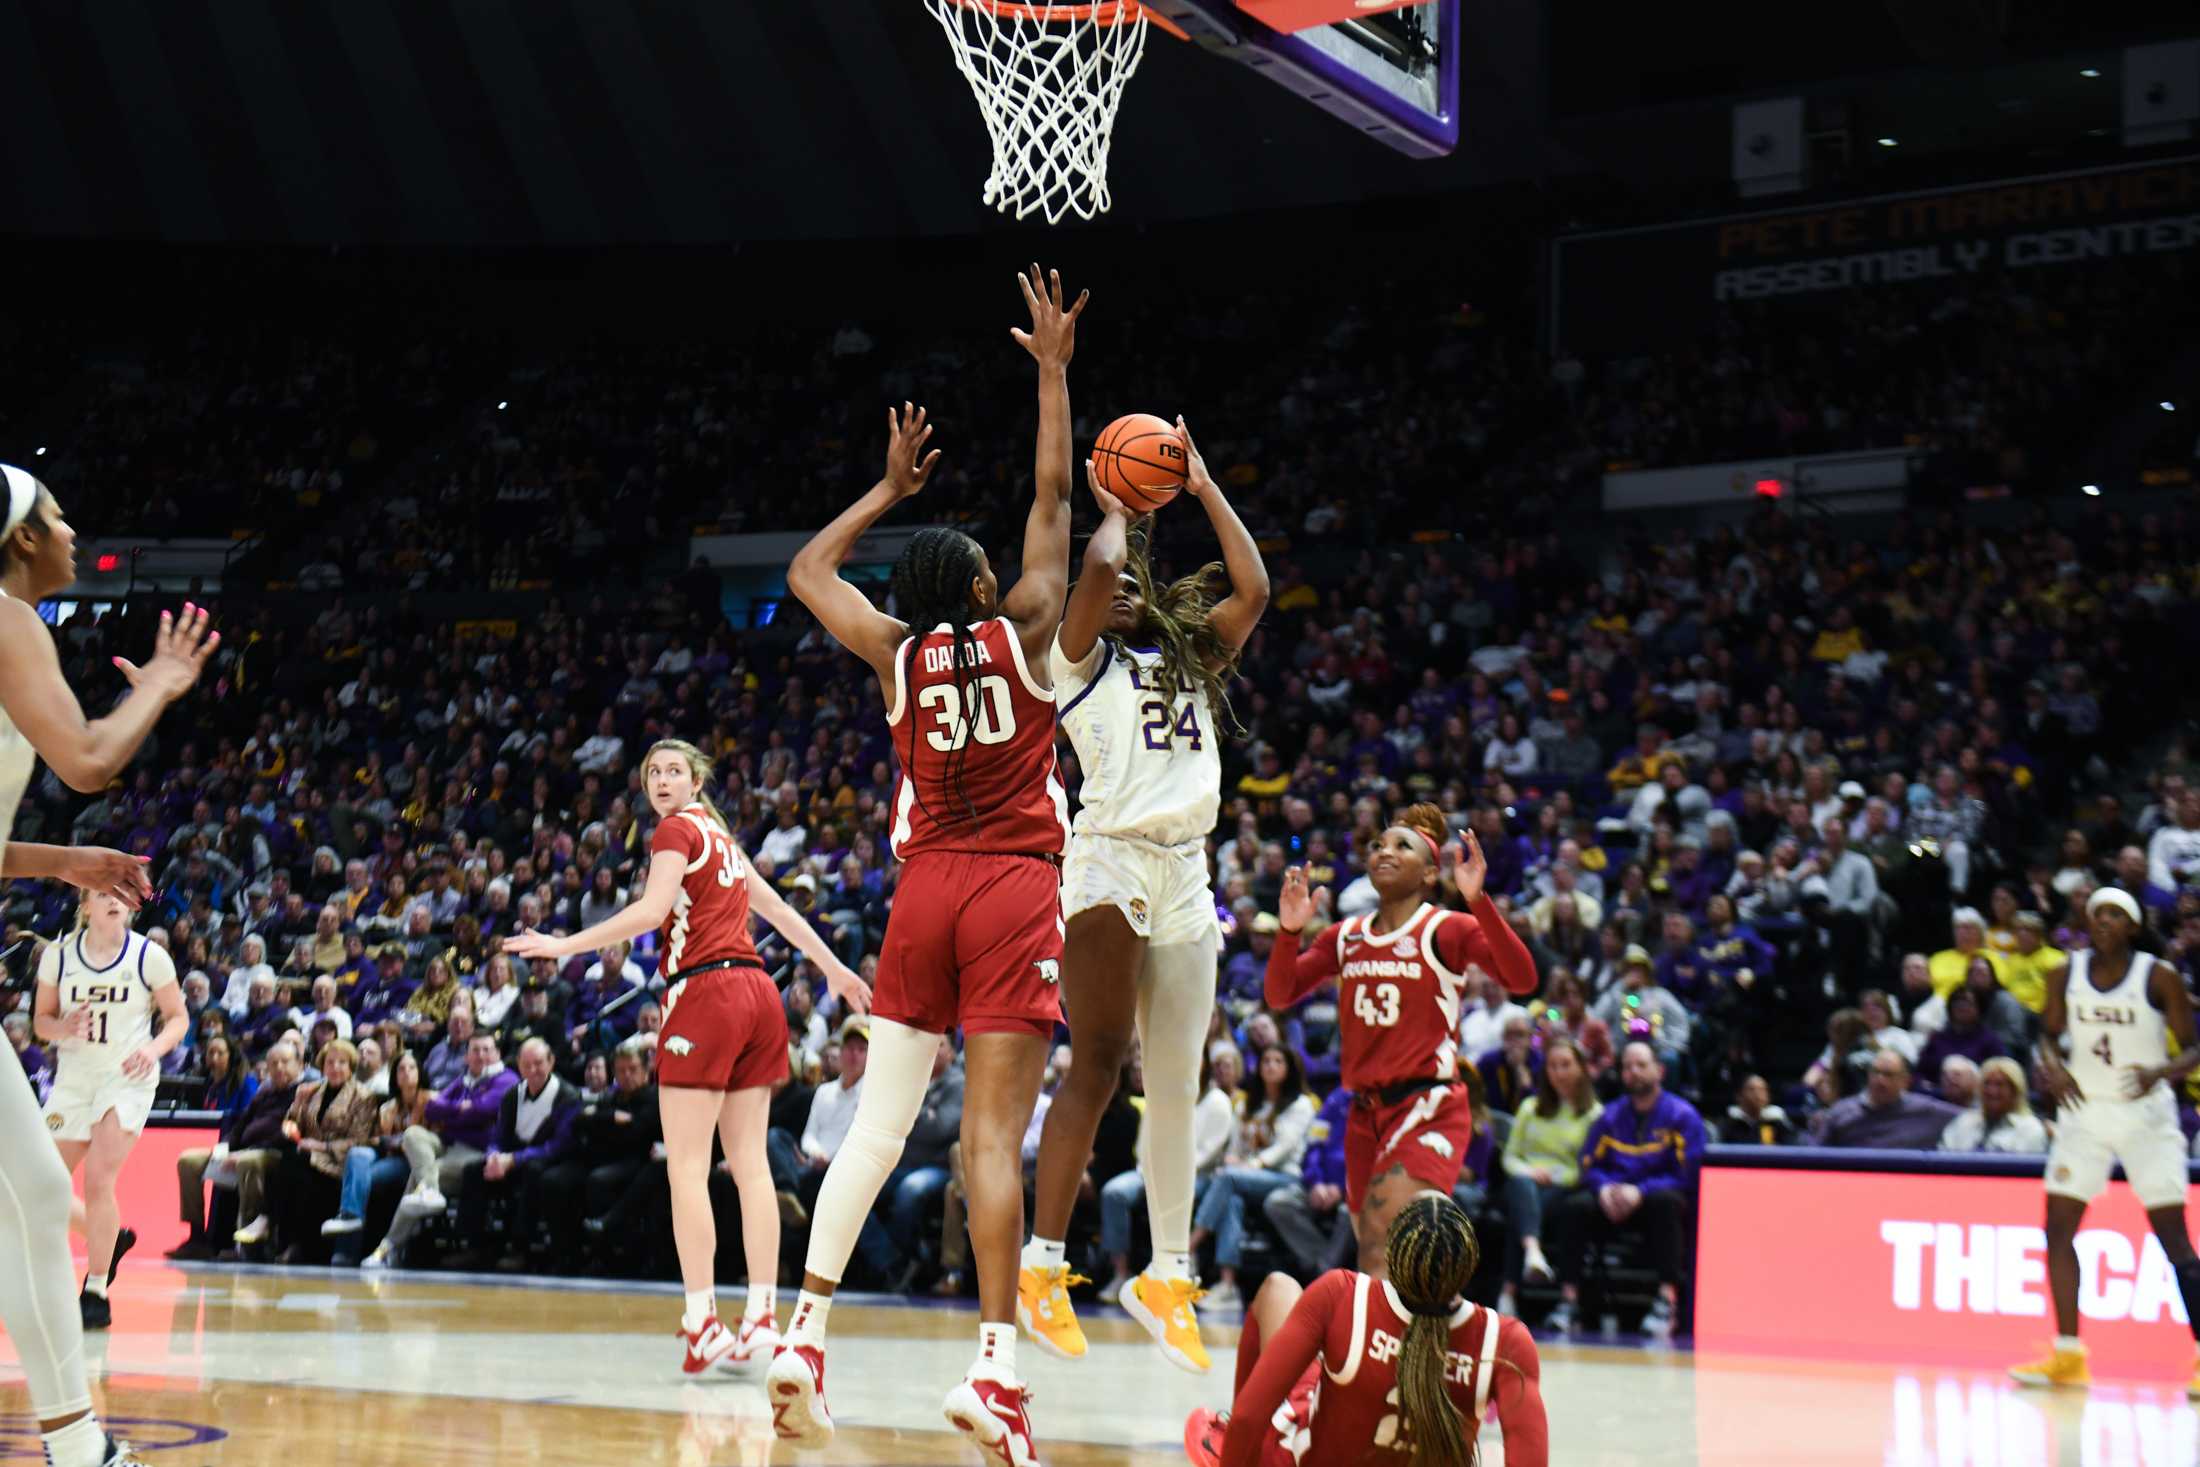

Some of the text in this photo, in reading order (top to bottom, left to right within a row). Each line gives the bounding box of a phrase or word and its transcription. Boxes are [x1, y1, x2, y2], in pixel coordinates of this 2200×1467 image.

[1719, 206, 1863, 258] PETE
[1714, 239, 1990, 300] ASSEMBLY
[918, 674, 1017, 752] 30
[1141, 701, 1202, 751] 24
[71, 985, 129, 1003] LSU
[1353, 983, 1400, 1027] 43
[2076, 1006, 2136, 1025] LSU
[2091, 1032, 2114, 1066] 4
[1880, 1219, 2200, 1325] THE CA
[1368, 1327, 1474, 1387] SPER
